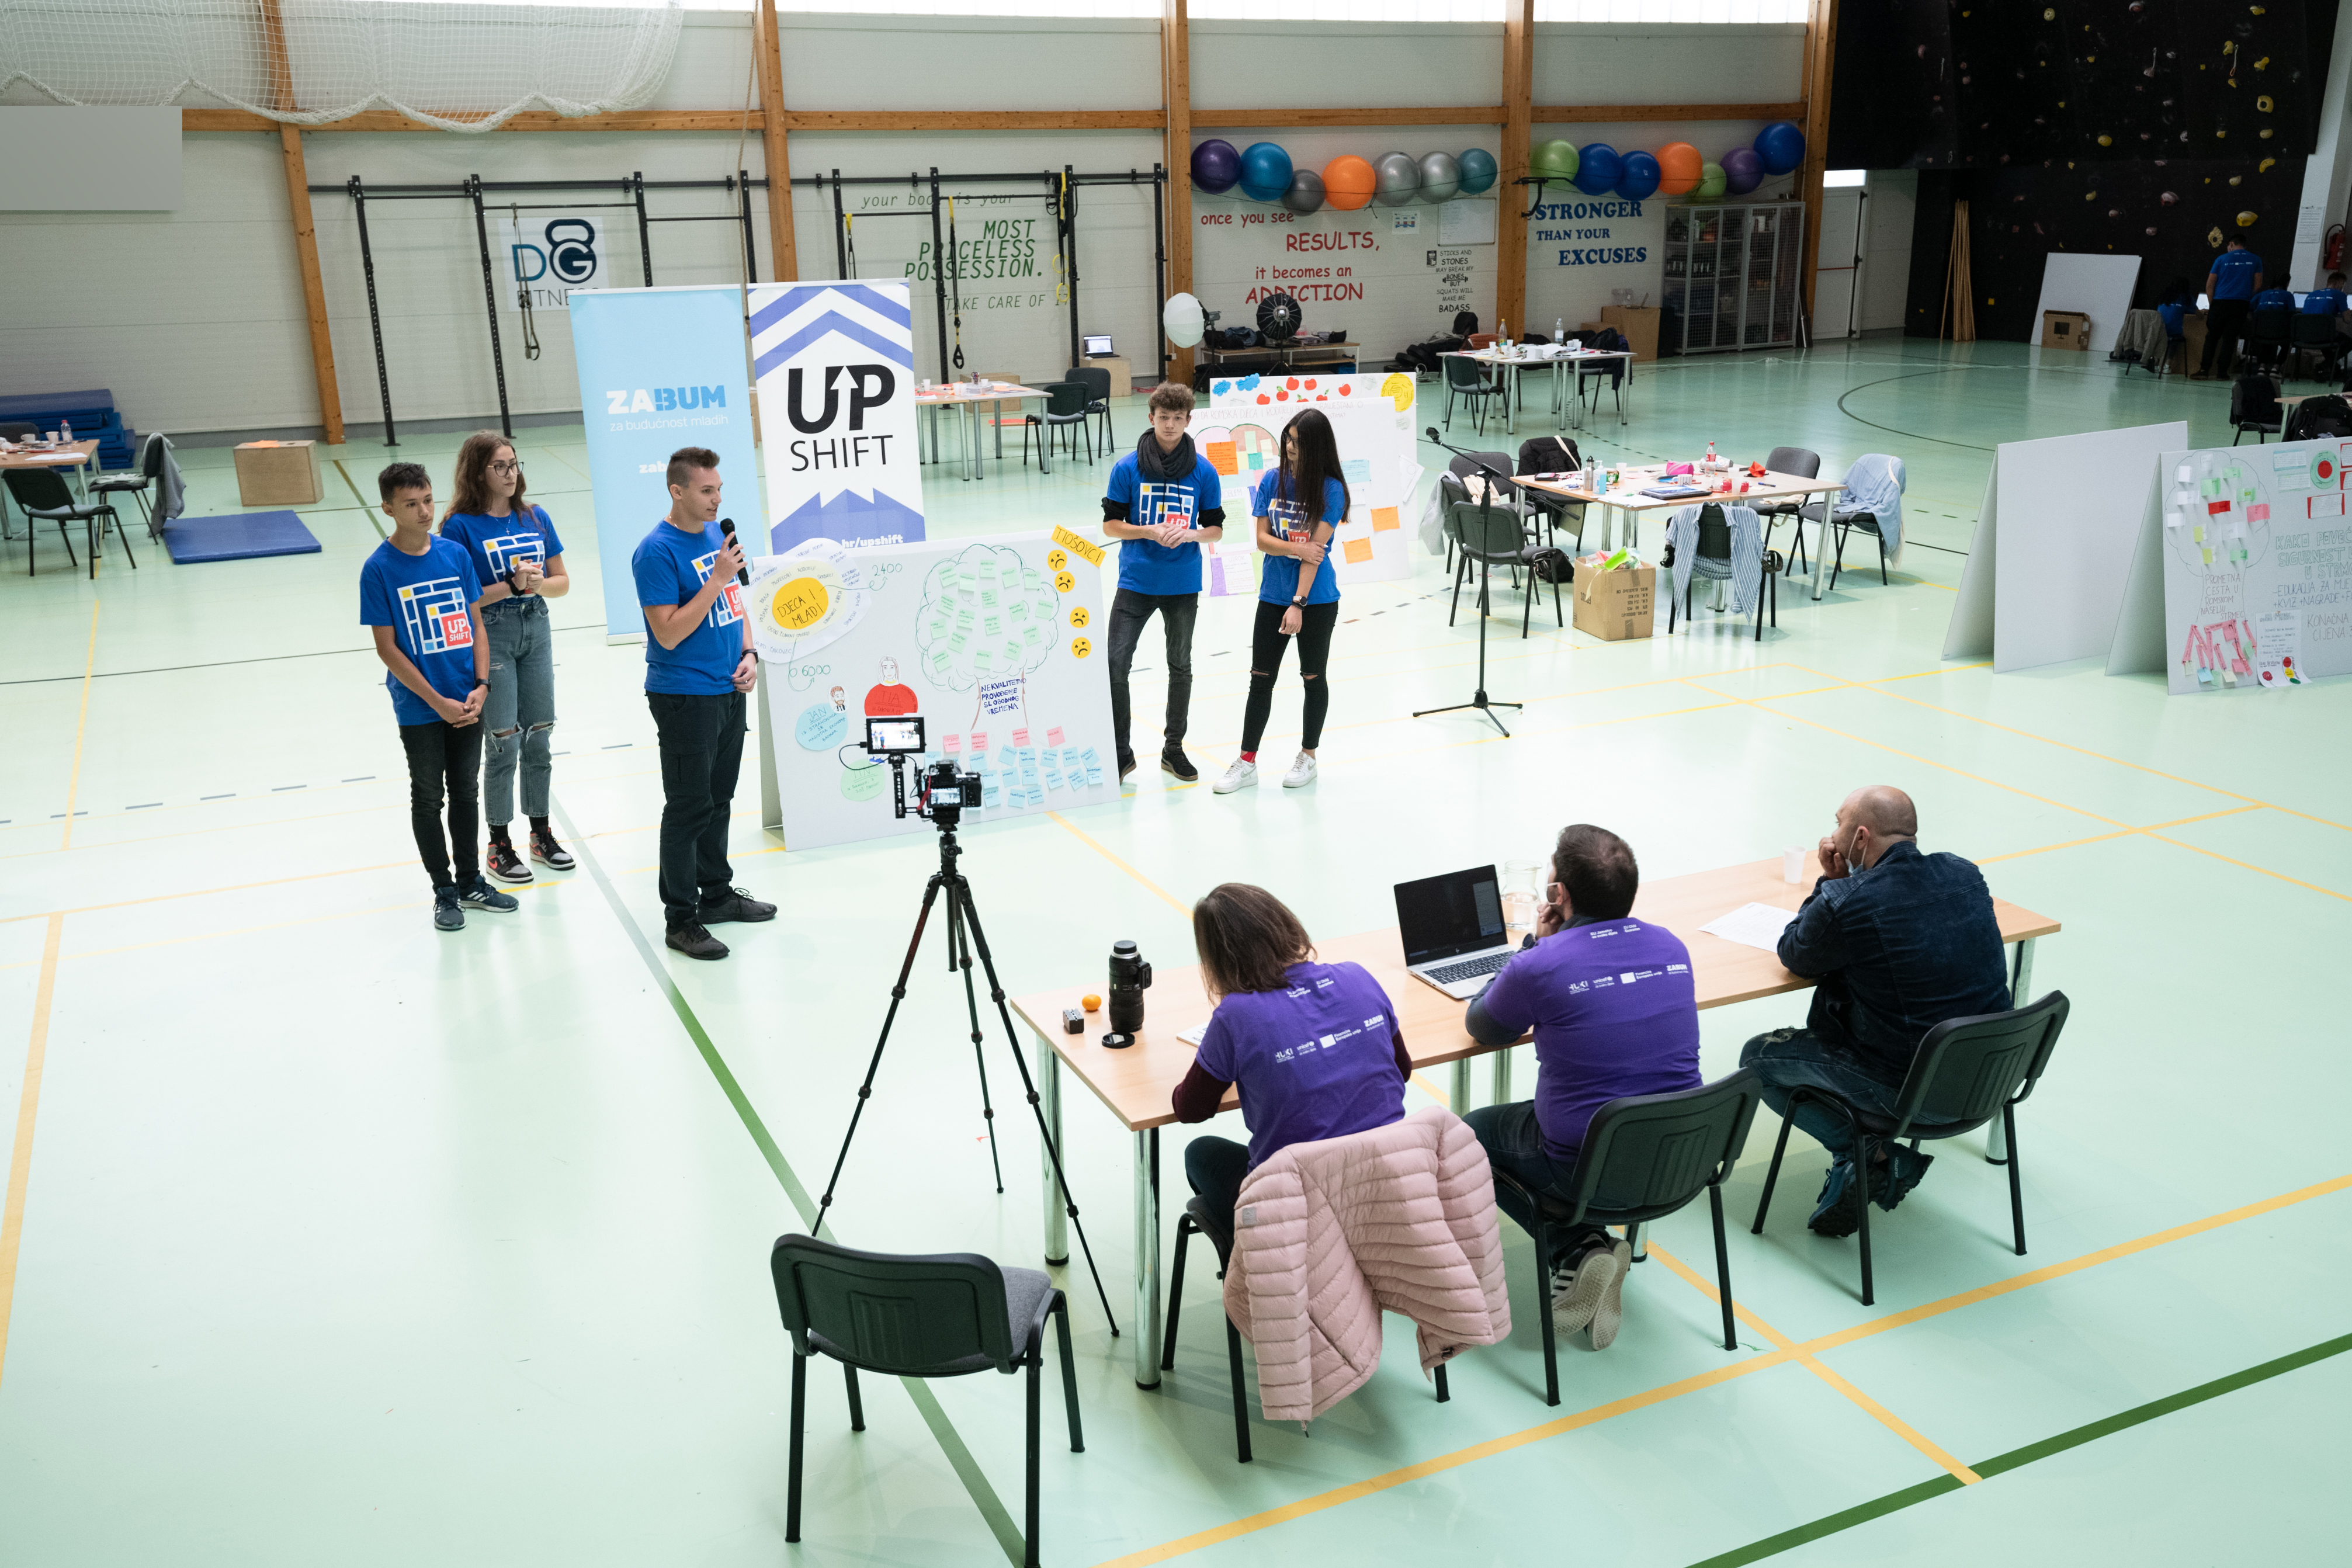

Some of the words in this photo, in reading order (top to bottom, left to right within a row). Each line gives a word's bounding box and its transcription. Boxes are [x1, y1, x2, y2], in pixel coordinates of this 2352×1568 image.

[862, 195, 898, 209] your
[1535, 201, 1642, 221] STRONGER
[1201, 213, 1233, 226] once
[1241, 212, 1265, 228] you
[1271, 211, 1295, 223] see
[983, 219, 1036, 240] MOST
[1536, 230, 1572, 241] THAN
[1576, 228, 1611, 240] YOUR
[1287, 231, 1380, 252] RESULTS,
[1558, 247, 1647, 266] EXCUSES
[1256, 266, 1266, 280] it
[1272, 265, 1330, 279] becomes
[1337, 266, 1352, 277] an
[945, 296, 980, 311] TAKE
[988, 294, 1022, 309] CARE
[1029, 294, 1046, 307] OF
[1439, 304, 1470, 313] BADASS
[606, 385, 726, 414] ZABUM
[788, 364, 895, 434] UP
[1201, 411, 1209, 420] DA
[1210, 409, 1238, 420] ROMSKA
[1240, 408, 1258, 419] DJECA
[1266, 405, 1294, 417] RODITELJI
[610, 422, 623, 432] za
[626, 417, 688, 431] budućnost
[691, 414, 729, 426] mladih
[790, 435, 893, 471] SHIFT
[2276, 533, 2309, 550] KAKO
[2278, 546, 2346, 567] SIGURNOST
[872, 563, 903, 577] 2400
[2304, 565, 2312, 580] U
[771, 571, 792, 586] PROFESORI
[2205, 573, 2241, 585] PROMETNA
[2205, 585, 2231, 596] CESTA
[2234, 584, 2239, 594] U
[2320, 581, 2330, 592] ZA
[777, 595, 806, 618] DJECA
[2205, 595, 2234, 607] ROMSKOM
[792, 602, 824, 627] MLADI
[2201, 605, 2226, 616] NASELJU
[2220, 610, 2245, 620] STRMEC
[447, 618, 467, 634] UP
[2307, 612, 2349, 629] KONAČNA
[449, 630, 469, 642] SHIFT
[2313, 626, 2346, 641] CIJENA
[802, 664, 831, 677] 6000
[981, 678, 1027, 693] NEKVALITETNO
[882, 690, 900, 706] TIA
[983, 695, 1019, 708] SLOBODNOG
[807, 707, 827, 723] JAN
[986, 703, 1019, 715] VREMENA
[808, 729, 828, 743] MAGISTAR
[1593, 976, 1608, 984] unicef
[1296, 1042, 1310, 1050] unicef
